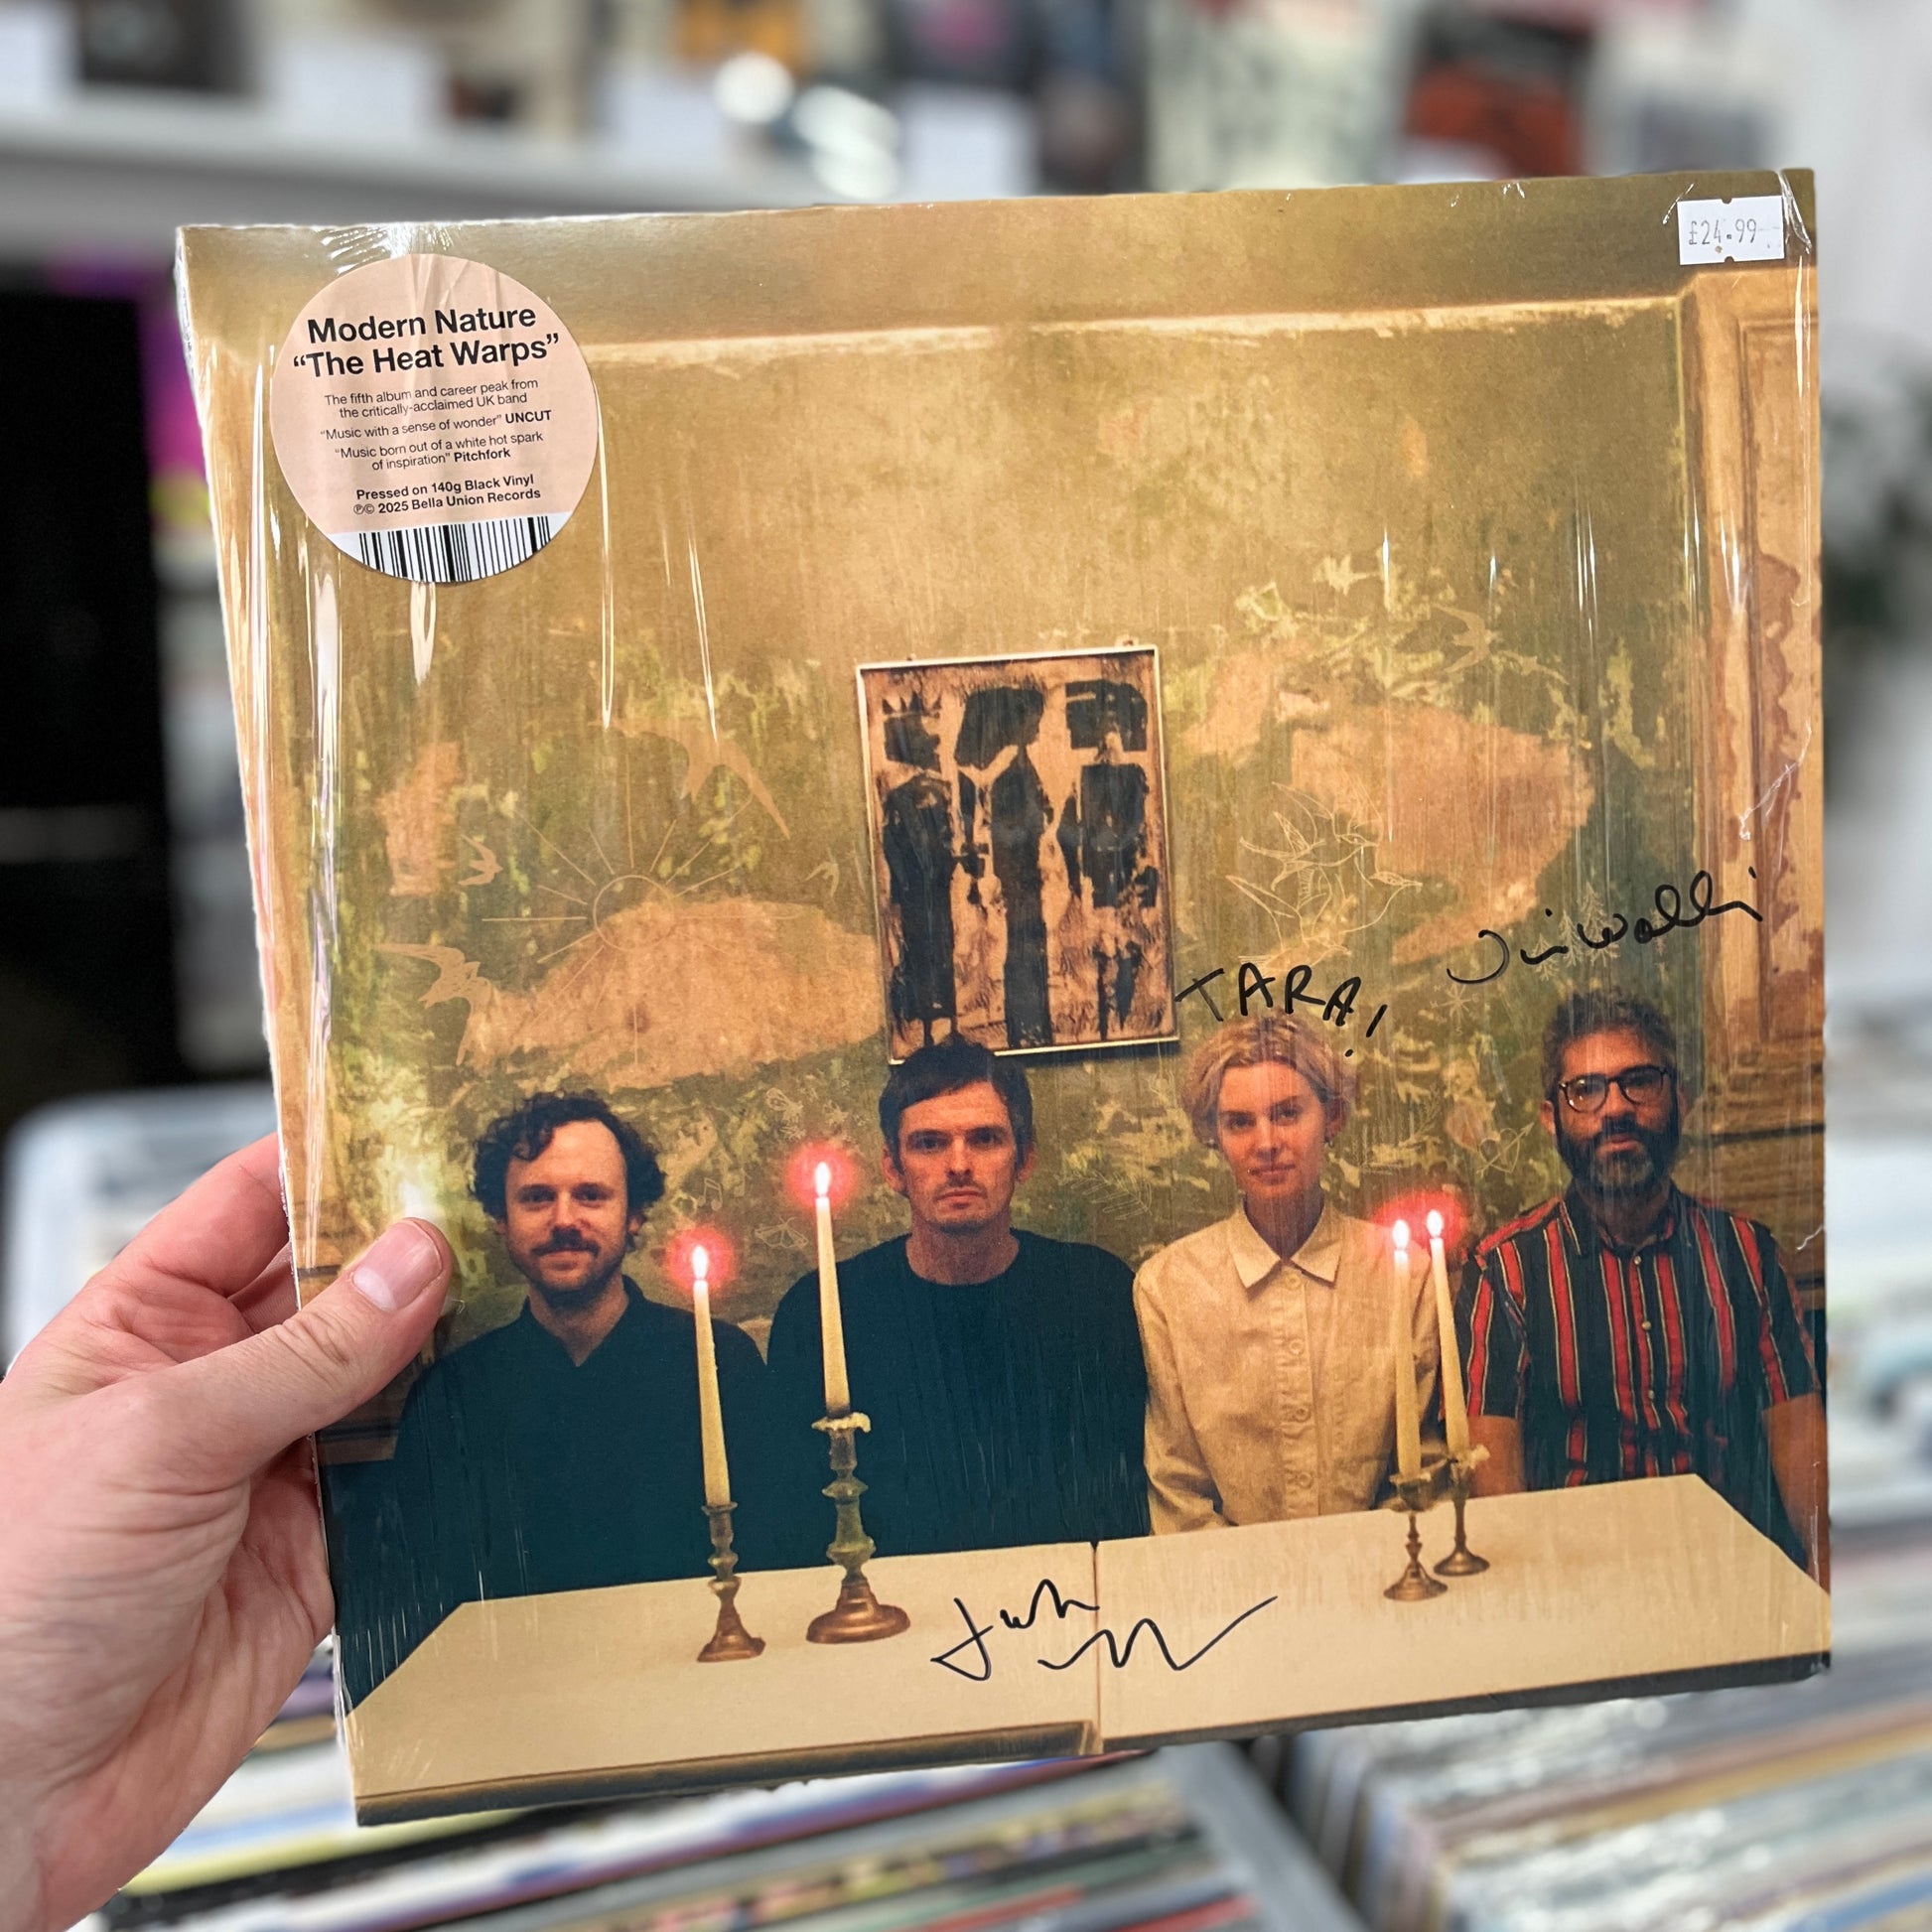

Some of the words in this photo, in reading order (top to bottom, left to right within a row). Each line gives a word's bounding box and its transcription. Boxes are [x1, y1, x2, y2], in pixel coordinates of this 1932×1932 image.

[1689, 218, 1757, 245] £24.99
[308, 316, 426, 344] Modern
[435, 308, 536, 335] Nature
[294, 351, 364, 377] “The
[373, 345, 444, 371] Heat
[450, 333, 559, 366] Warps”
[325, 394, 347, 405] The
[349, 392, 373, 404] fifth
[376, 390, 412, 403] album
[414, 386, 437, 398] and
[440, 385, 478, 397] career
[481, 380, 509, 395] peak
[511, 378, 539, 390] from
[340, 407, 359, 418] the
[361, 397, 474, 418] critically-acclaimed
[477, 395, 495, 407] UK
[497, 392, 527, 405] band
[364, 426, 389, 438] with
[392, 426, 399, 435] a
[402, 421, 436, 434] sense
[439, 419, 451, 431] of
[504, 409, 552, 424] UNCUT
[379, 445, 407, 457] born
[409, 441, 428, 453] out
[430, 439, 443, 451] of
[445, 441, 453, 450] a
[456, 436, 486, 450] white
[488, 435, 508, 447] hot
[510, 431, 544, 446] spark
[371, 459, 383, 471] of
[454, 447, 511, 463] Pitchfork
[356, 485, 409, 500] Pressed
[412, 486, 428, 495] on
[431, 482, 462, 494] 140g
[465, 478, 501, 491] Black
[502, 474, 534, 488] Vinyl
[378, 500, 409, 514] 2025
[412, 495, 443, 510] Bella
[446, 493, 484, 507] Union
[487, 487, 541, 503] Records
